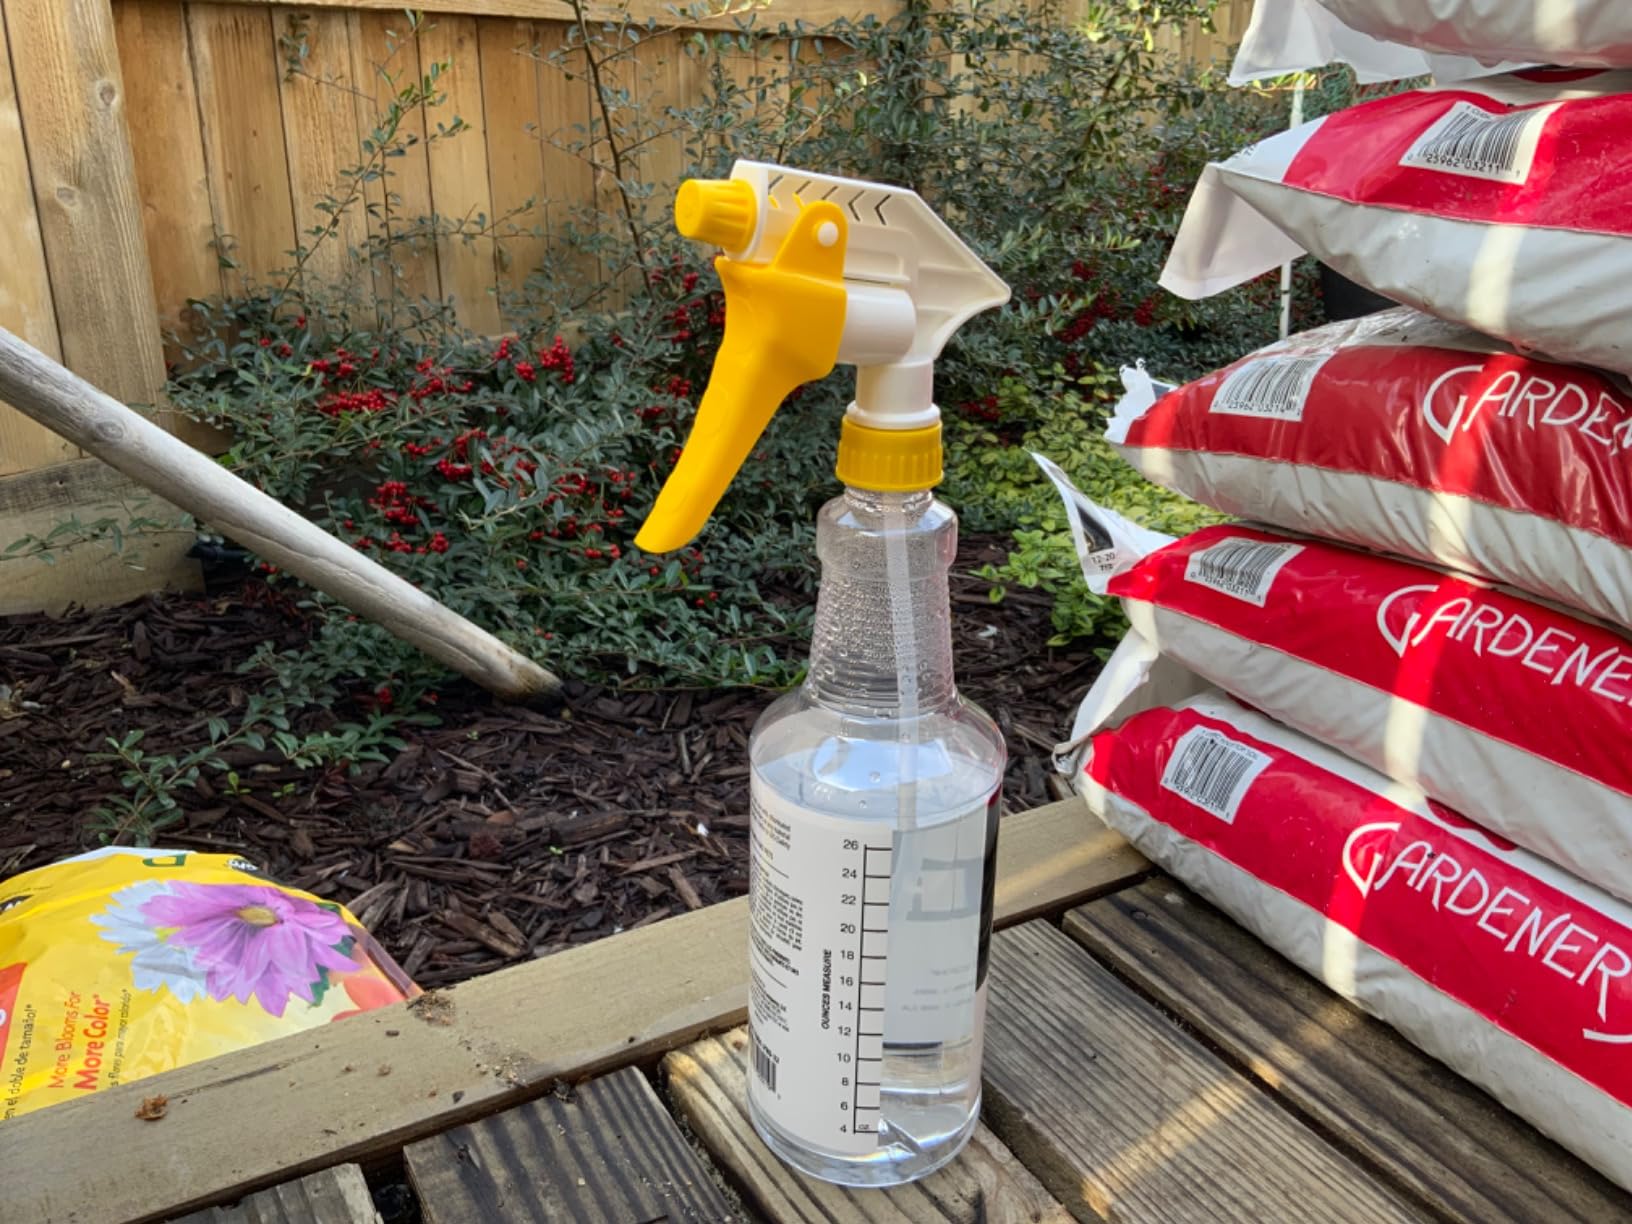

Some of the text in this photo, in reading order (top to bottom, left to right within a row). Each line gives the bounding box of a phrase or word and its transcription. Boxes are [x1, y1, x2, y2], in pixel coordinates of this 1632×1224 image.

[1376, 584, 1632, 707] GARDENE
[843, 839, 859, 850] 26
[842, 868, 857, 879] 24
[841, 894, 857, 905] 22
[840, 923, 856, 934] 20
[1342, 822, 1632, 1043] GARDENER
[840, 949, 855, 960] 18
[839, 976, 854, 987] 16
[821, 949, 832, 1030] OUNCES MEASURE
[838, 1000, 852, 1011] 14
[838, 1026, 852, 1037] 12
[48, 990, 82, 1088] More Blooms For
[14, 1051, 29, 1066] de
[837, 1052, 851, 1063] 10
[73, 1041, 105, 1090] More
[841, 1077, 849, 1087] 8
[840, 1101, 848, 1111] 6
[840, 1124, 847, 1133] 4
